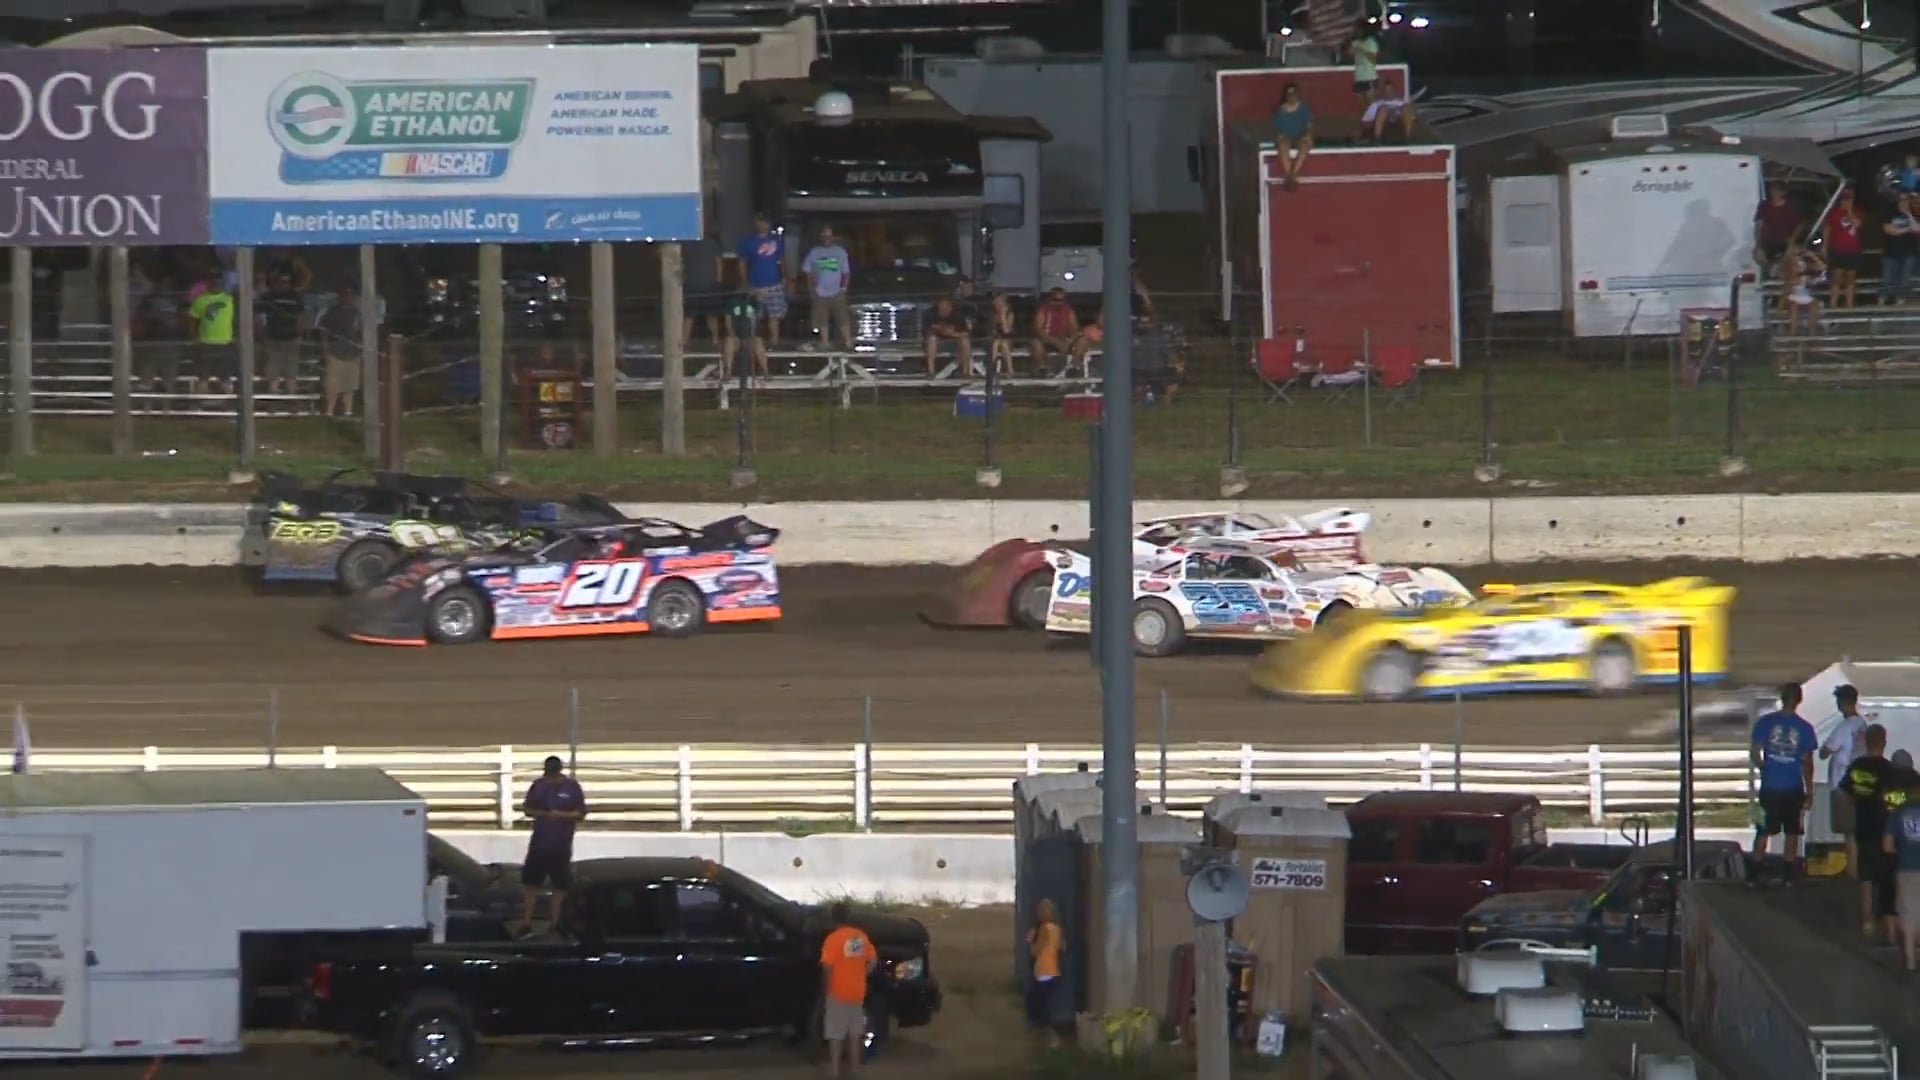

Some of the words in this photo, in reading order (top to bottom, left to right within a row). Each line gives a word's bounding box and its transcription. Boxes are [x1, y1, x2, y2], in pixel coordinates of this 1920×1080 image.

[364, 91, 514, 113] AMERICAN
[370, 115, 502, 137] ETHANOL
[410, 152, 491, 176] NASCAR
[845, 170, 929, 183] SENECA
[562, 560, 644, 607] 20
[1254, 873, 1324, 888] 571-7809
